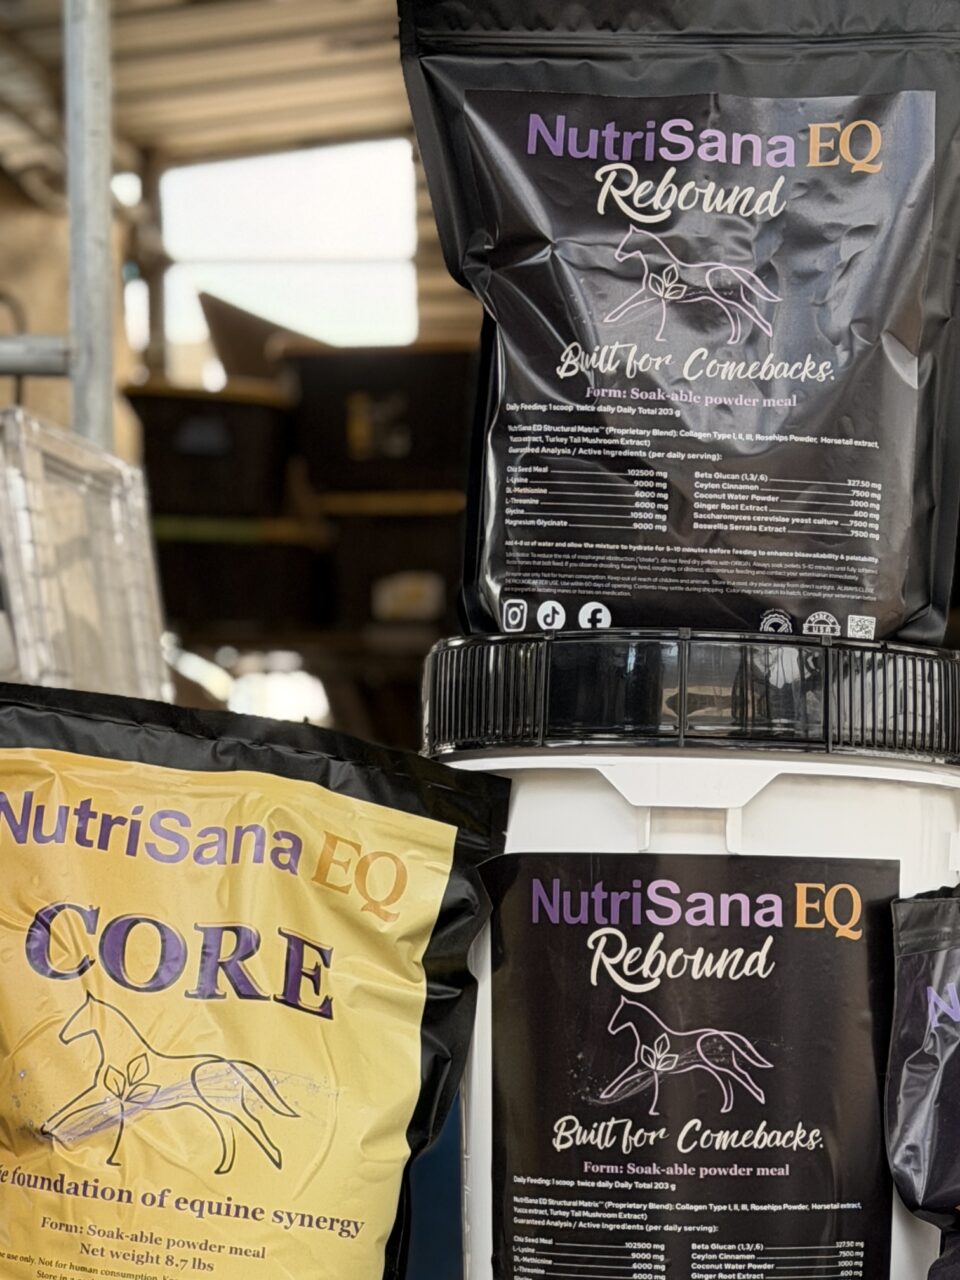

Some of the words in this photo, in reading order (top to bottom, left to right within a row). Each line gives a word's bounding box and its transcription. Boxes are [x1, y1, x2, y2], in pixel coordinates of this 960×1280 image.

[526, 113, 796, 168] NutriSana
[806, 119, 883, 174] EQ
[595, 163, 787, 223] Rebound
[556, 341, 620, 378] Built
[624, 343, 673, 379] for
[682, 347, 835, 382] Comebacks.
[585, 387, 626, 399] Form:
[630, 388, 700, 402] Soak-able
[704, 393, 759, 406] powder
[762, 394, 796, 407] meal
[596, 404, 615, 413] daily
[616, 405, 636, 415] Daily
[638, 406, 657, 415] Total
[658, 407, 673, 415] 203
[0, 790, 303, 875] NutriSana
[312, 831, 408, 922] EQ
[531, 878, 783, 928] NutriSana
[794, 882, 863, 940] EQ
[25, 901, 334, 1021] CORE
[587, 928, 775, 993] Rebound
[553, 1114, 616, 1151] Built
[617, 1117, 669, 1154] for
[677, 1119, 824, 1153] Comebacks.
[577, 1179, 595, 1187] twice
[596, 1180, 613, 1189] daily
[614, 1180, 633, 1189] Daily
[634, 1180, 653, 1189] Total
[653, 1181, 669, 1189] 203
[583, 1161, 623, 1173] Form:
[626, 1162, 696, 1175] Soak-able
[699, 1164, 753, 1178] powder
[756, 1164, 789, 1175] meal
[10, 1167, 133, 1202] foundation
[140, 1188, 171, 1208] of
[174, 1196, 265, 1220] equine
[271, 1210, 365, 1238] synergy
[41, 1216, 83, 1233] Form:
[86, 1224, 162, 1244] Soak-able
[166, 1238, 225, 1252] powder
[229, 1246, 265, 1258] meal
[79, 1242, 104, 1257] Net
[109, 1249, 160, 1265] weight
[164, 1254, 188, 1270] 8.7
[192, 1257, 214, 1271] lbs
[18, 1255, 36, 1265] only.
[38, 1256, 53, 1267] Not
[54, 1259, 67, 1269] for
[68, 1261, 98, 1274] human
[36, 1269, 57, 1280] Store
